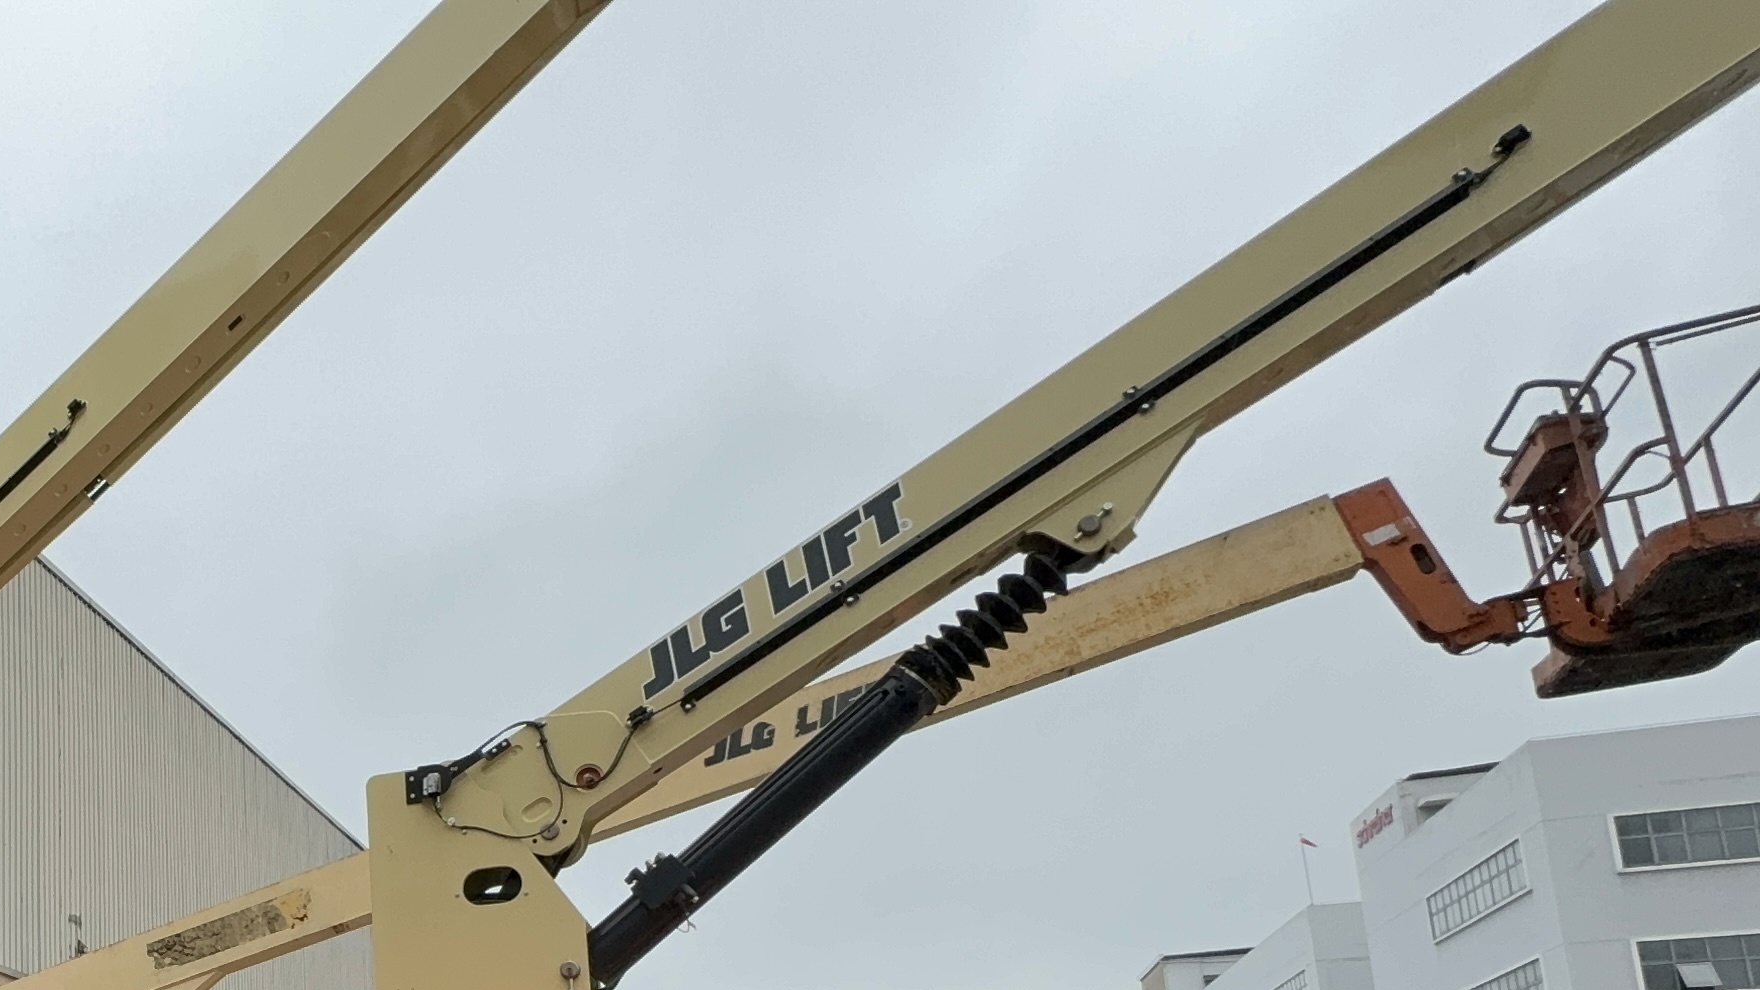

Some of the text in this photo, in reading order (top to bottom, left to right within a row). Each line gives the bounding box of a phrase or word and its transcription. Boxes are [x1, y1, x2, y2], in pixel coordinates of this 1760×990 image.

[642, 481, 903, 700] JLG LIFT
[704, 721, 776, 768] JLG
